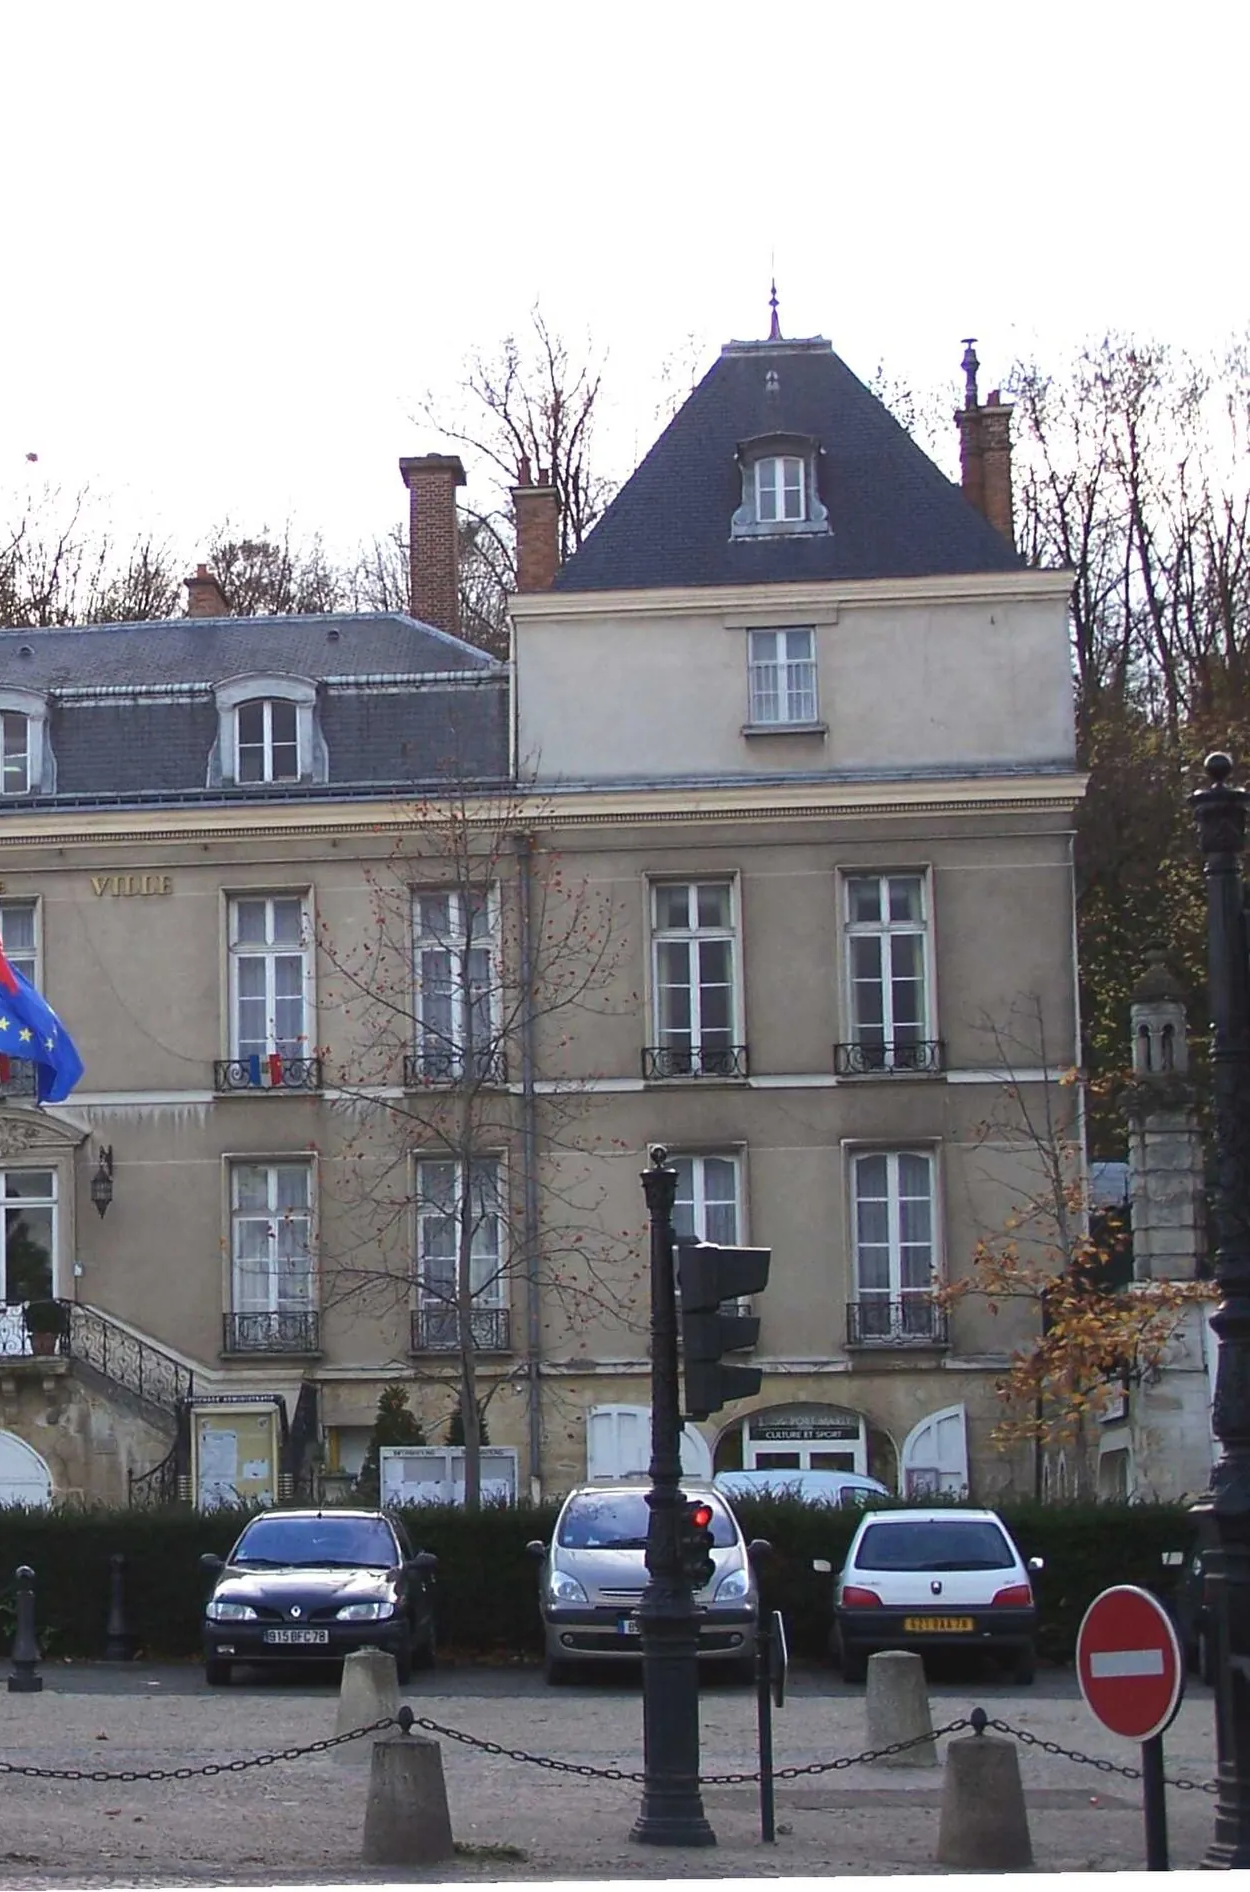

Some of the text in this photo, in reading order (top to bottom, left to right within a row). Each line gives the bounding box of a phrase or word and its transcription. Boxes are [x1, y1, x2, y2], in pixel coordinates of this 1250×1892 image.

[91, 876, 173, 897] VILLE
[765, 1431, 801, 1439] CULTURE
[815, 1430, 843, 1438] SPORT
